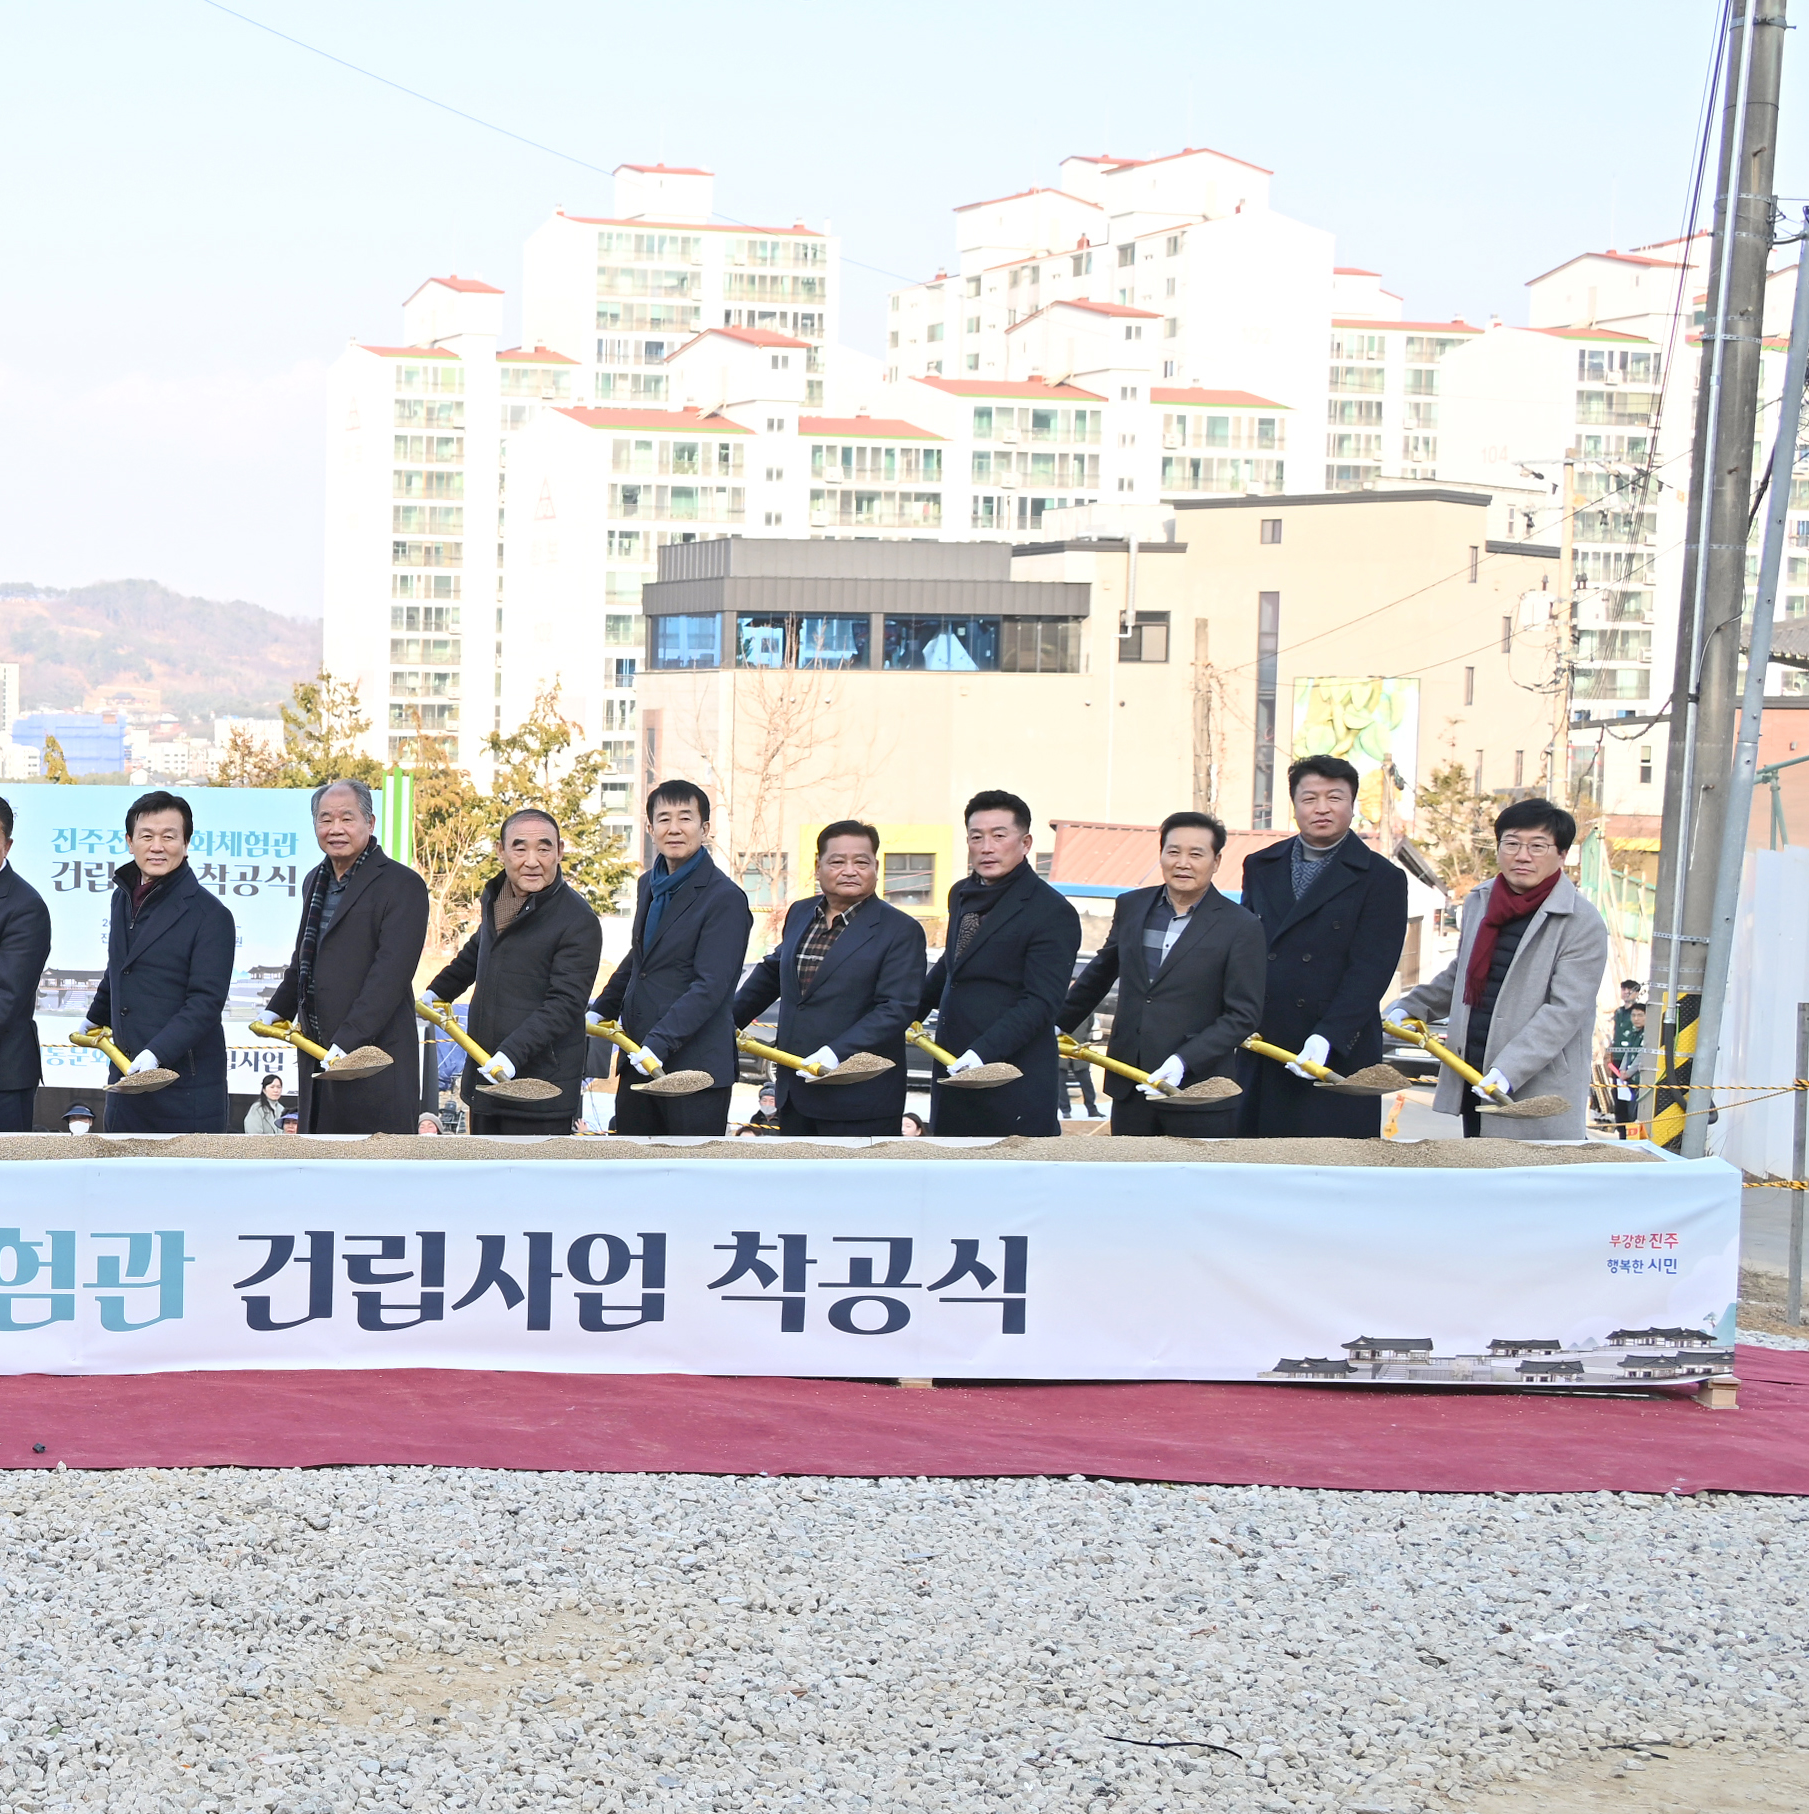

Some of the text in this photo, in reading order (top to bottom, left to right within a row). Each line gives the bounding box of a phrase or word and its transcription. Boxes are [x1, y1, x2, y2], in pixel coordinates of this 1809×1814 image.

[1480, 445, 1508, 465] 104
[51, 828, 299, 858] 진주전화체험관
[198, 862, 297, 897] 착공식
[1609, 1232, 1679, 1249] 부강한 진주
[1606, 1257, 1678, 1275] 행복한 시민
[232, 1230, 668, 1334] 건립사업
[706, 1230, 1029, 1336] 착공식
